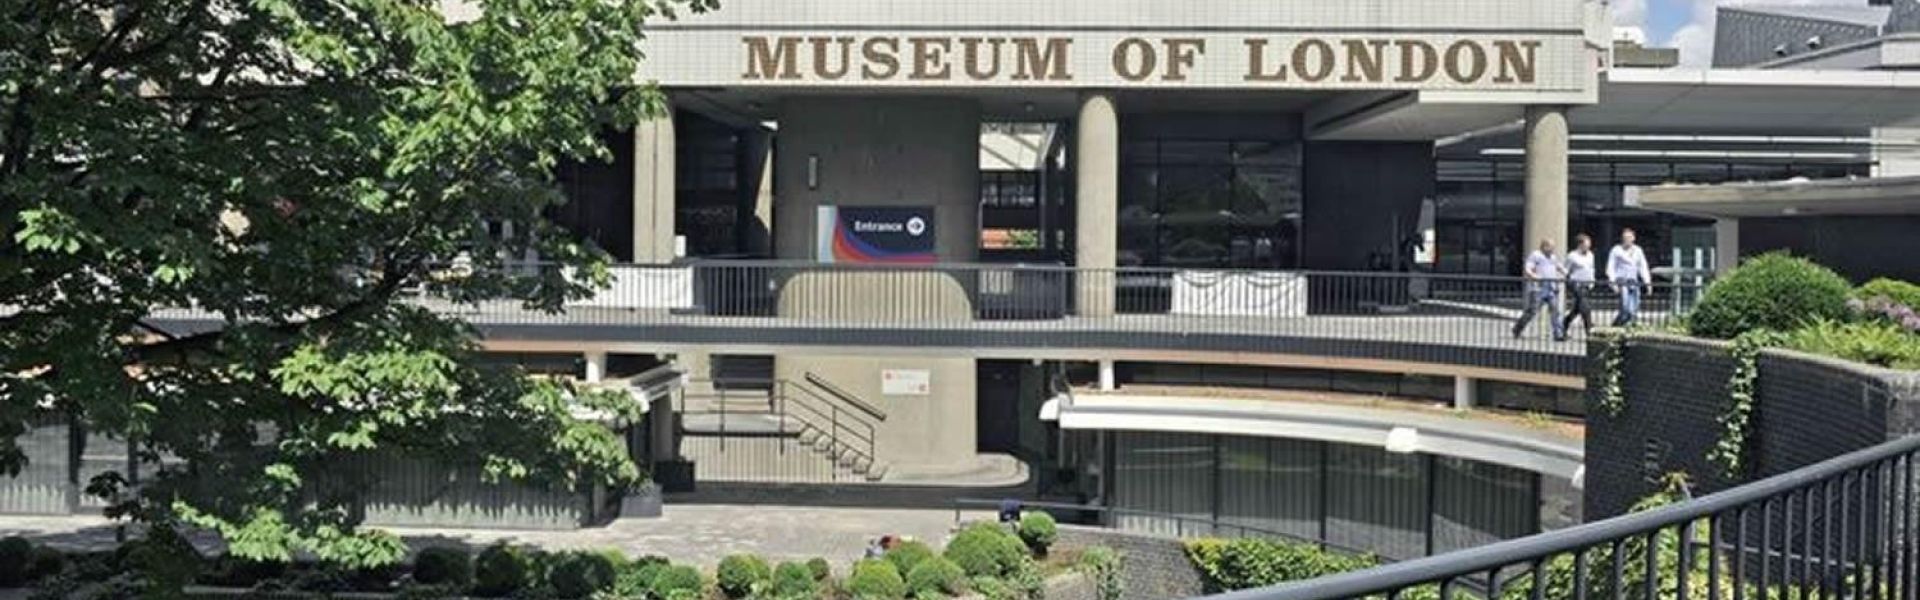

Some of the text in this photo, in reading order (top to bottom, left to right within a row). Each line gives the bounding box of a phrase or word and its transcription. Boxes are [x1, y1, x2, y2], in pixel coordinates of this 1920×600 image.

[742, 36, 1541, 84] MUSEUM OF LONDON
[854, 221, 903, 232] Entrance
